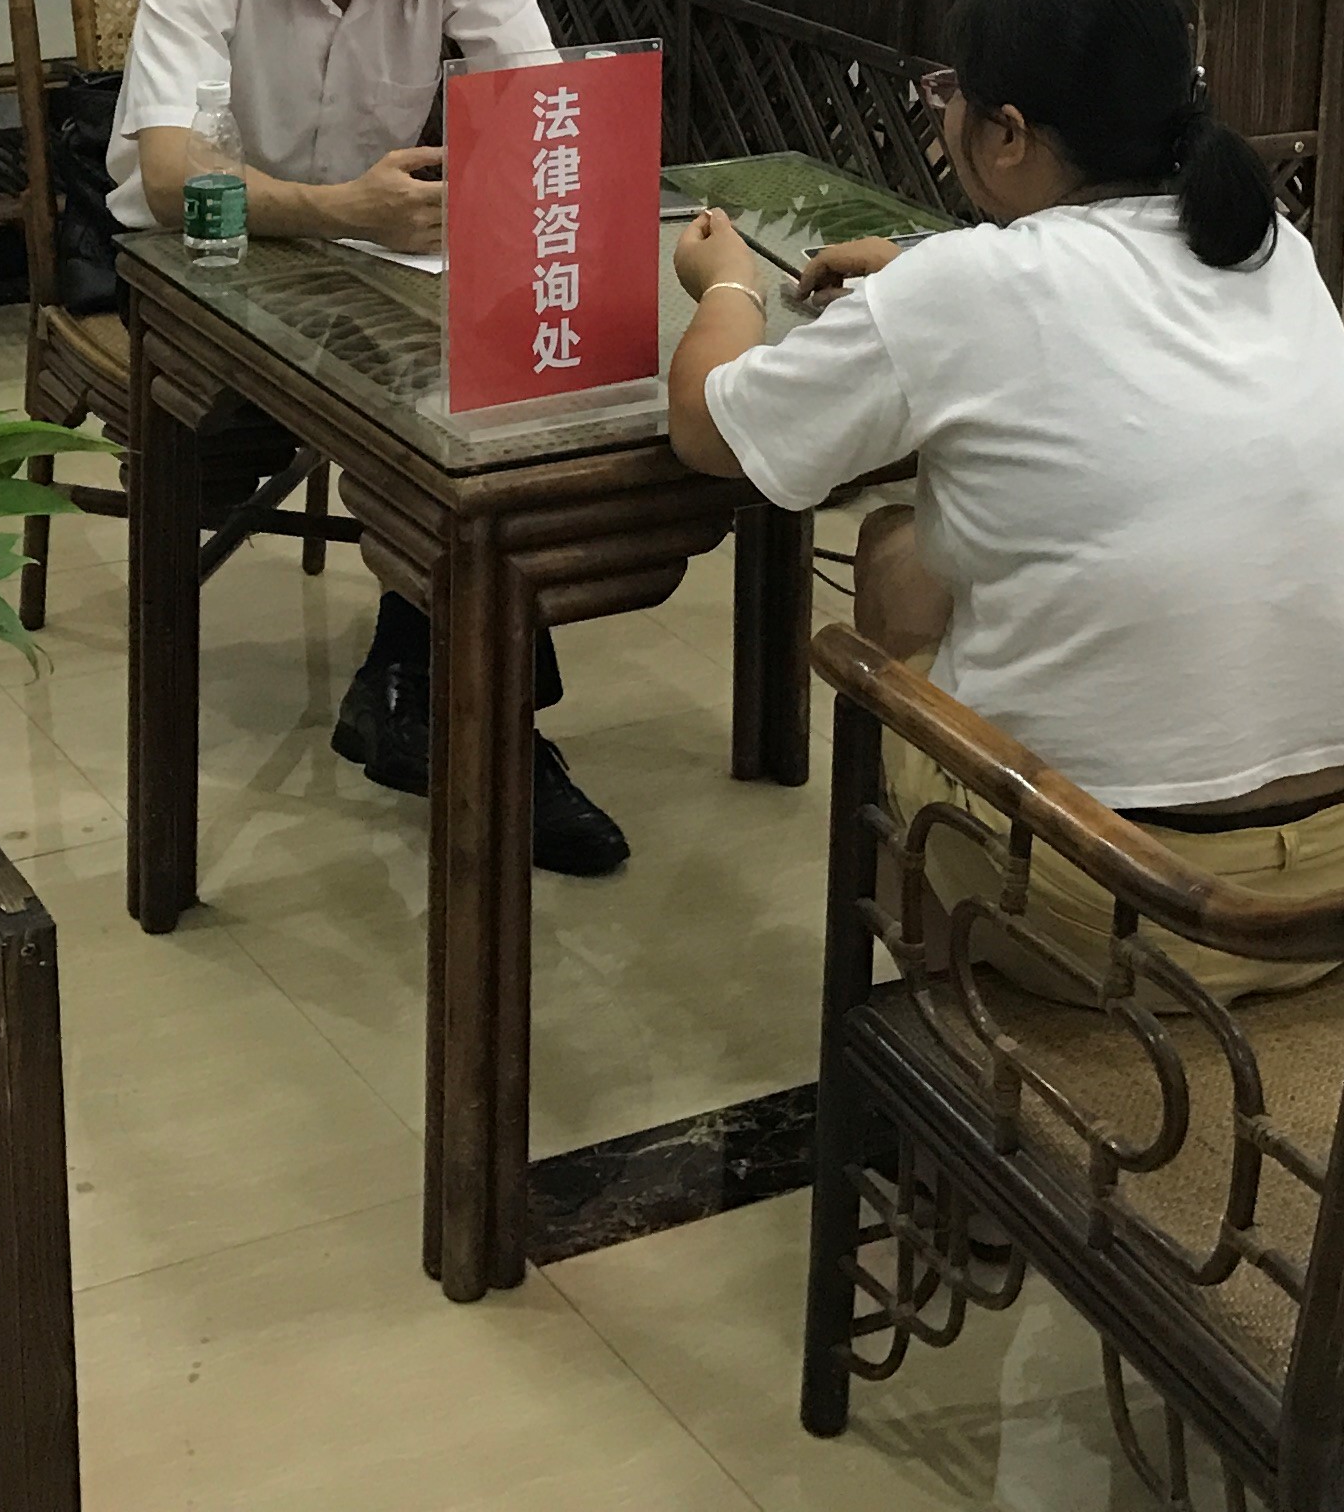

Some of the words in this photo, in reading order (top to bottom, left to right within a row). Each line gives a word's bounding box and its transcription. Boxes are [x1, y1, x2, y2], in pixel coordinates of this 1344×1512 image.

[531, 86, 582, 374] 法律咨询处
